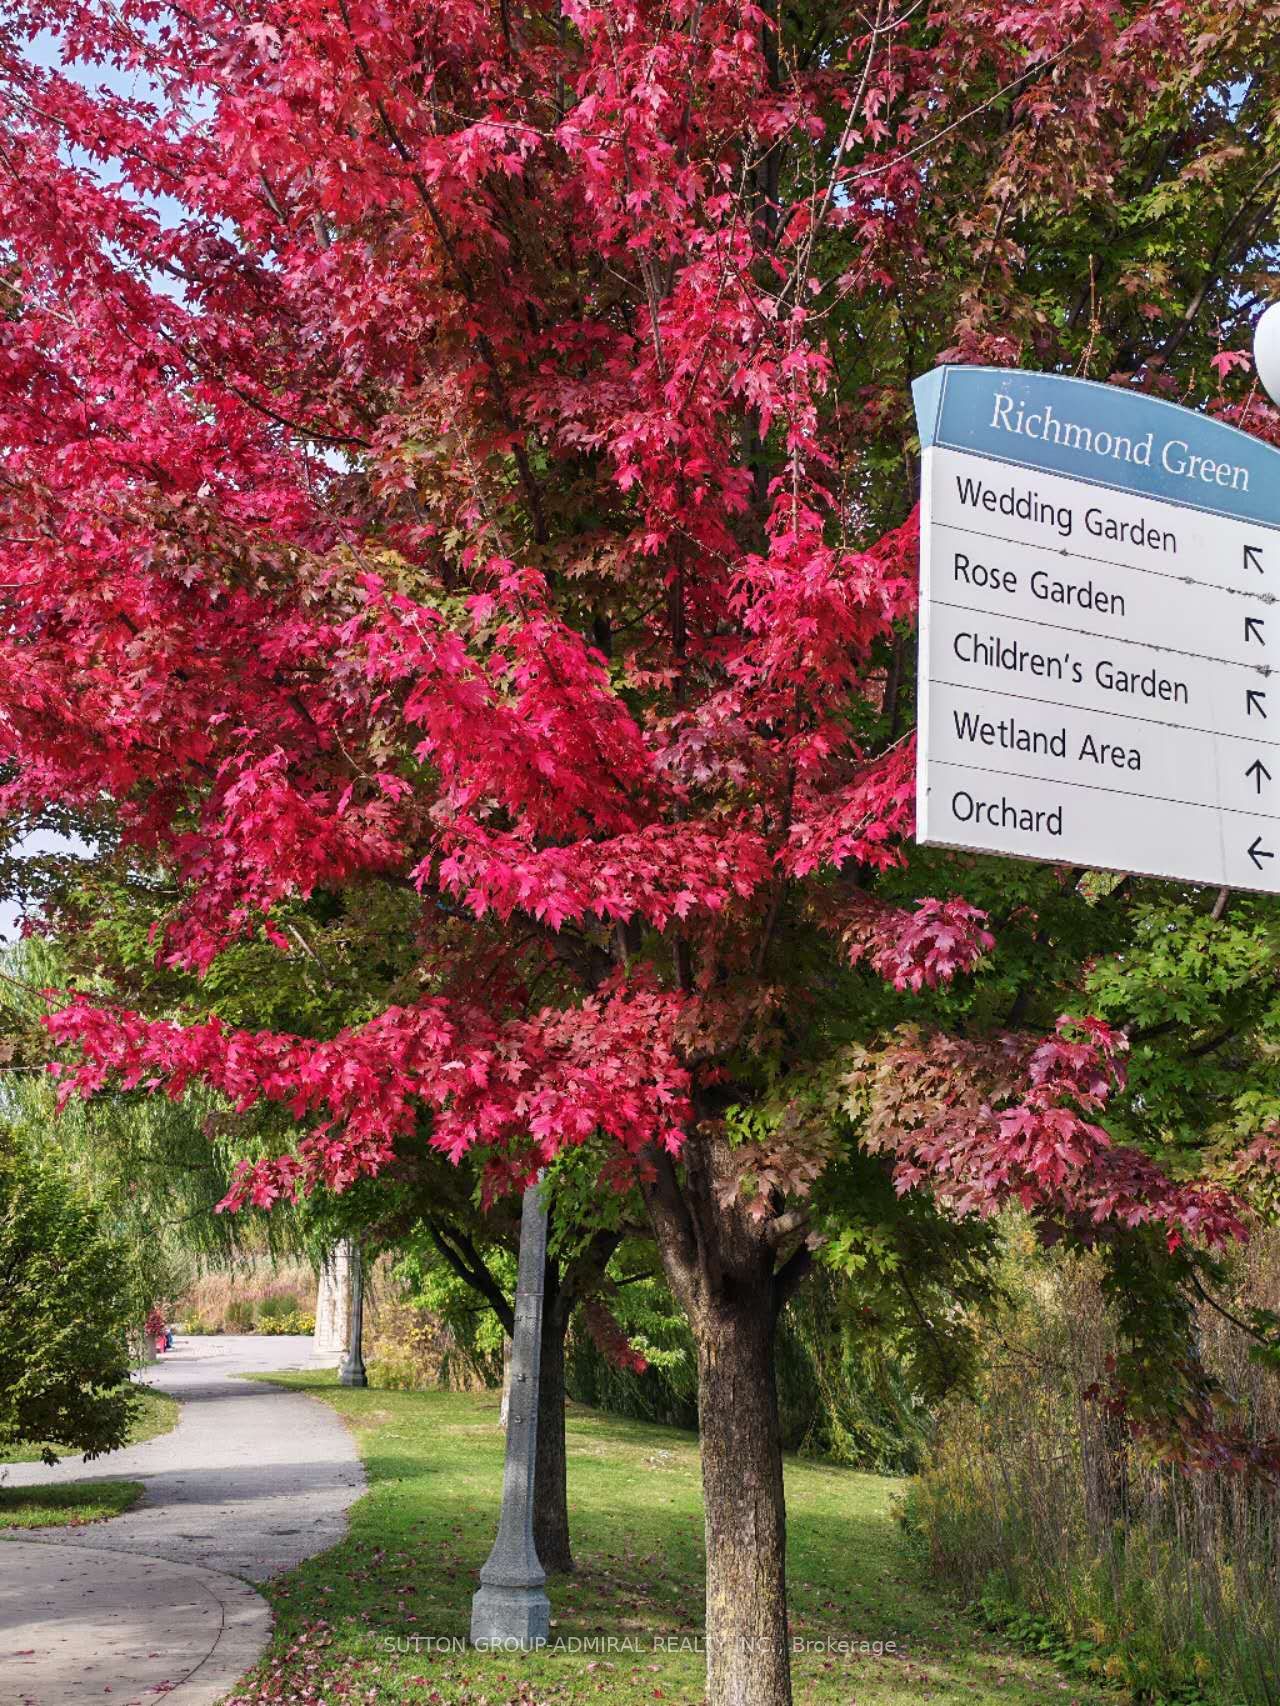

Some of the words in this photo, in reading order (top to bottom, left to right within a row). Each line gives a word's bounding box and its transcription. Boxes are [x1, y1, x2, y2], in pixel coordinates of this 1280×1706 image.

[991, 394, 1152, 466] Richmond
[1161, 438, 1250, 491] Green
[956, 476, 1073, 536] Wedding
[1085, 509, 1177, 553] Garden
[954, 553, 1017, 593] Rose
[1030, 570, 1125, 616] Garden
[953, 632, 1082, 683] Children's
[1095, 661, 1188, 704] Garden
[953, 710, 1066, 758] Wetland
[1078, 733, 1142, 771] Area
[951, 791, 1062, 836] Orchard
